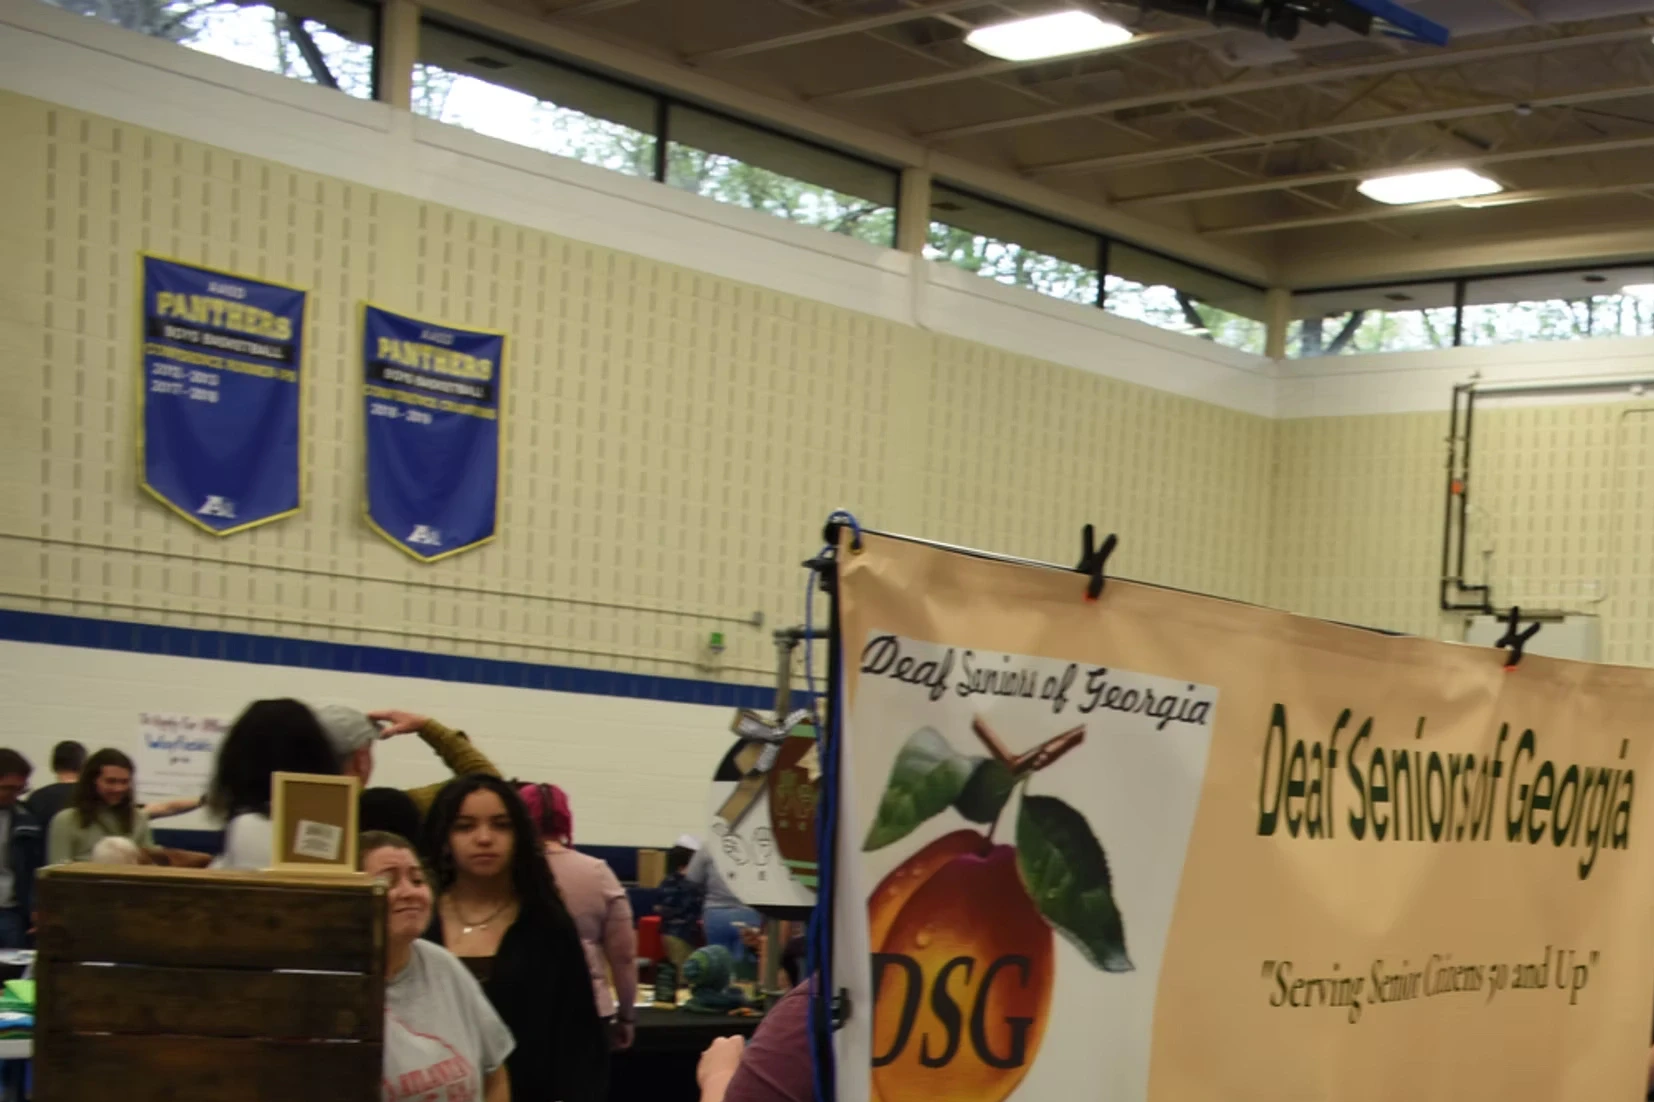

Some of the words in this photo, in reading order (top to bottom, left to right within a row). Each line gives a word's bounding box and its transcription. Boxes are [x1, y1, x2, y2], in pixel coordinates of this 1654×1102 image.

[156, 291, 293, 341] PANTHERS
[377, 336, 493, 381] PANTHERS
[861, 635, 954, 701] Deaf
[955, 649, 1039, 698] Seniors
[1040, 663, 1079, 714] of
[1077, 667, 1213, 730] Georgia
[1257, 703, 1352, 839] Deaf
[1347, 716, 1475, 842] Seniors
[1470, 722, 1510, 842] of
[1506, 728, 1635, 881] Georgia
[870, 952, 1034, 1069] DSG
[1261, 960, 1365, 1024] "Serving
[1367, 959, 1423, 1004] Senior
[1511, 945, 1553, 989] and
[1555, 949, 1600, 1006] Up"
